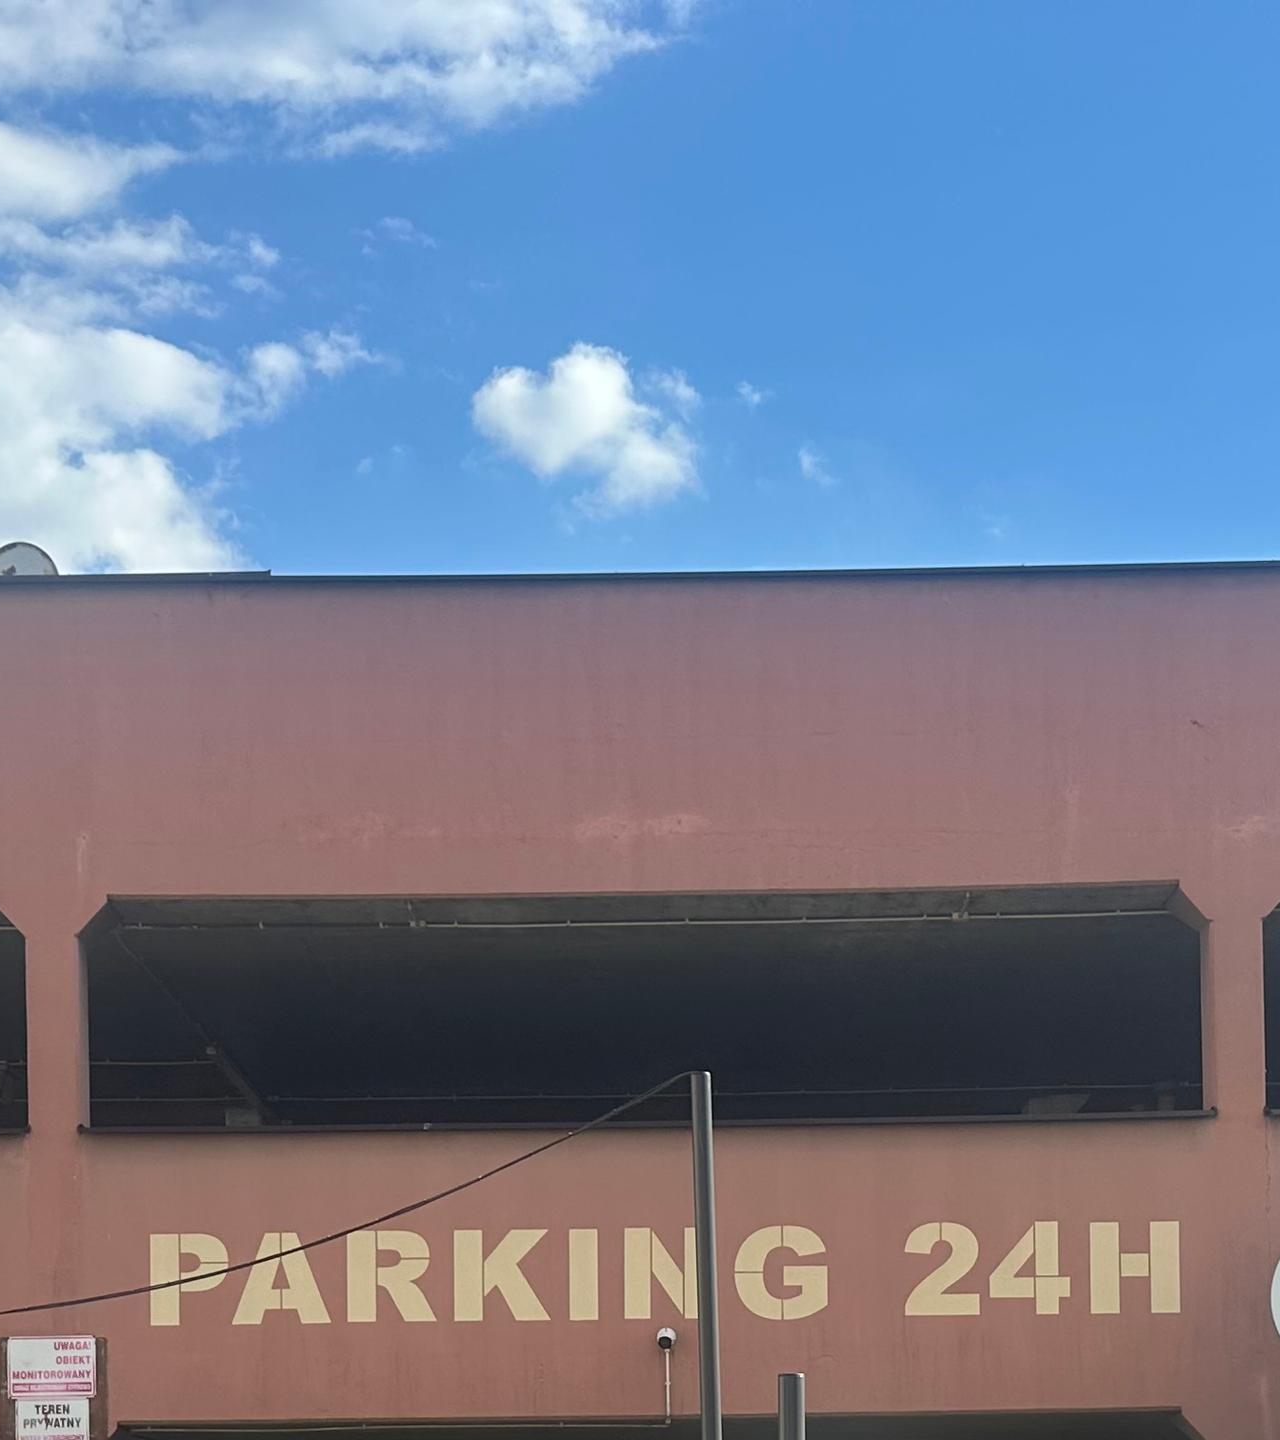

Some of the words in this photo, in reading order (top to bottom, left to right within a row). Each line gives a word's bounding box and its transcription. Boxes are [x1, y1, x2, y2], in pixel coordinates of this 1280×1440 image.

[150, 1226, 828, 1327] PARKING
[903, 1220, 1180, 1317] 24H
[56, 1356, 91, 1365] OBIEKT
[12, 1370, 91, 1380] MONITOROWANY
[35, 1404, 70, 1415] TEREN
[23, 1418, 81, 1429] PRYWATNY
